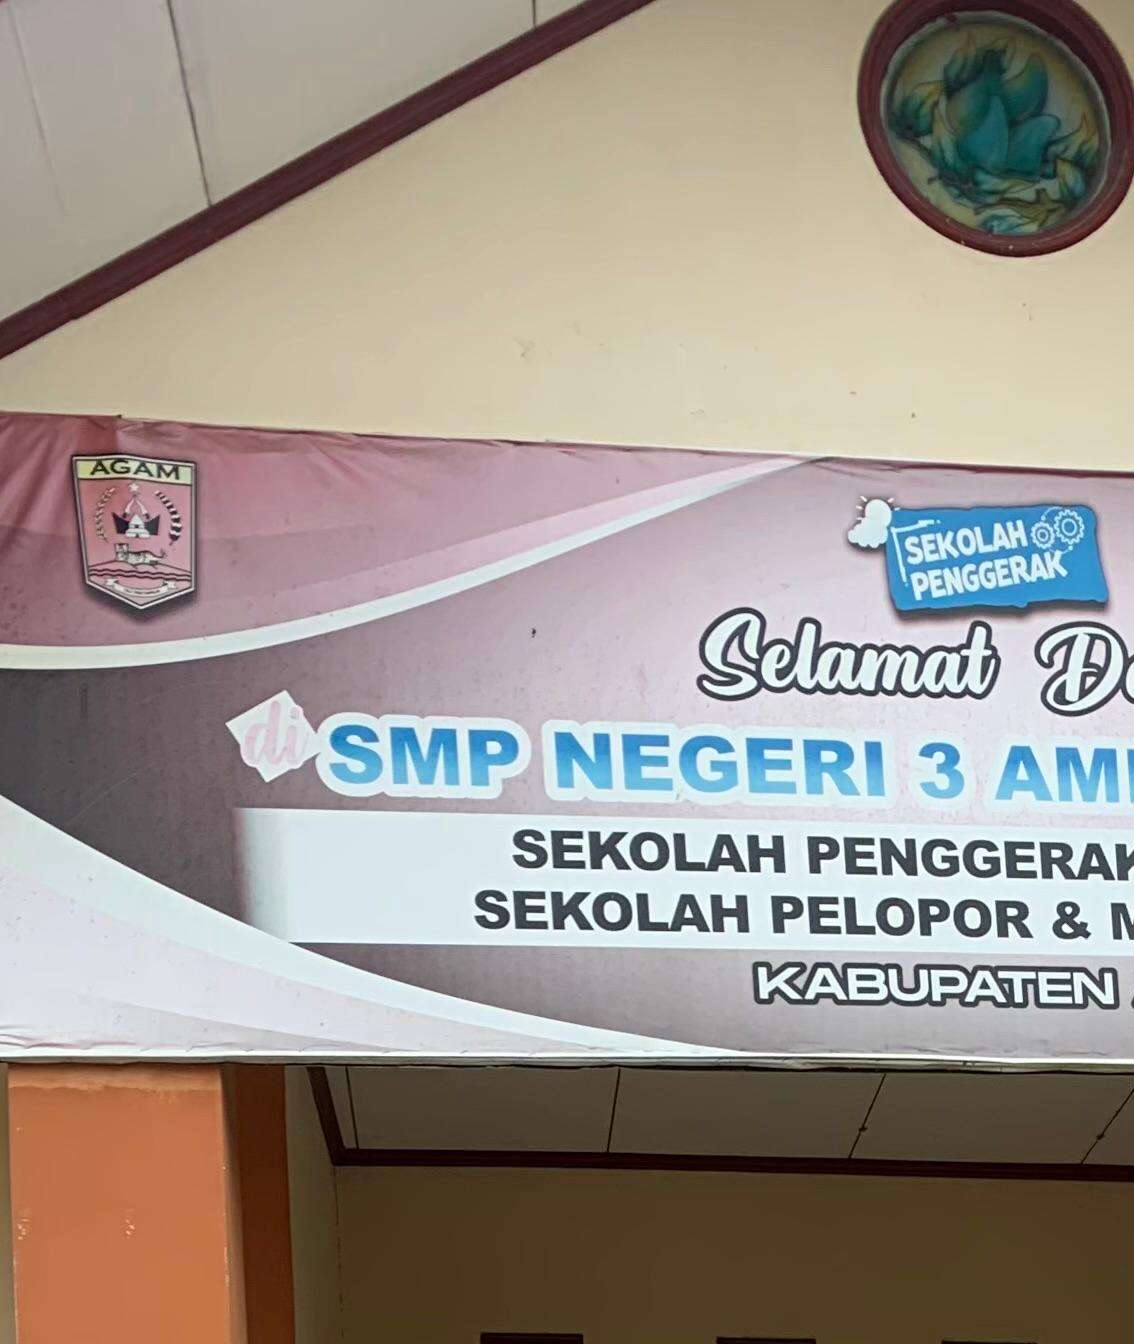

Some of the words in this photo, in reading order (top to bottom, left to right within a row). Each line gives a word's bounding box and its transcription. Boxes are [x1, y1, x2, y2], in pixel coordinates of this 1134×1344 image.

[89, 458, 181, 482] AGAM
[906, 520, 1028, 565] SEKOLAH
[910, 550, 1068, 600] PENGGERAK
[698, 607, 999, 702] Selamat
[328, 723, 520, 789] SMP
[554, 730, 885, 798] NEGERI
[919, 742, 965, 800] 3
[512, 829, 786, 874] SEKOLAH
[475, 890, 749, 934] SEKOLAH
[771, 895, 1033, 939] PELOPOR
[1052, 901, 1092, 940] &
[753, 961, 1119, 1010] KABUPATEN
